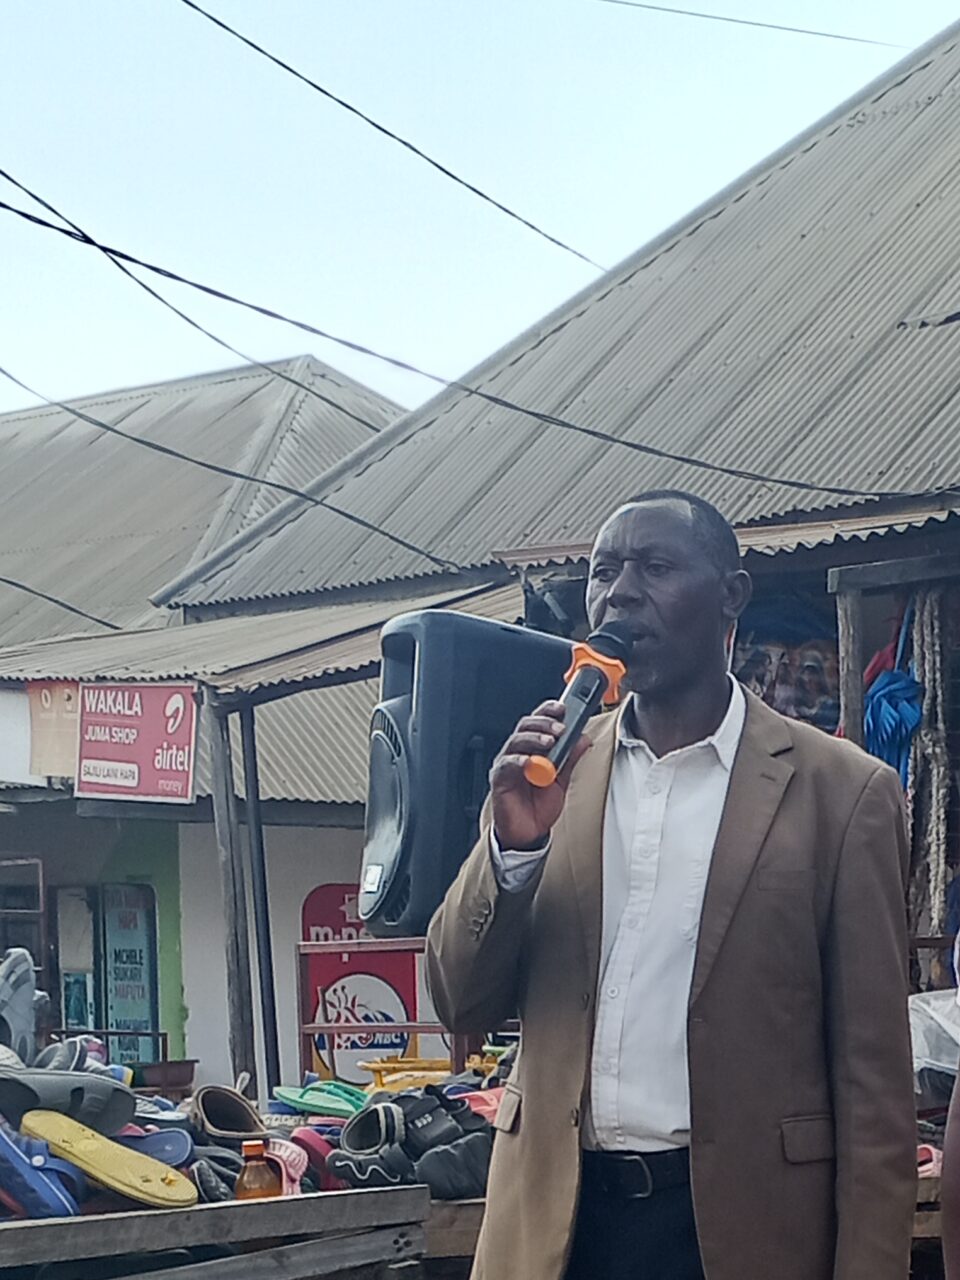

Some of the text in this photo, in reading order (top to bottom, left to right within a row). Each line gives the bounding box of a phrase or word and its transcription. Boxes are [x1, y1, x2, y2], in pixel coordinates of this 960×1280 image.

[84, 688, 142, 716] WAKALA
[84, 725, 138, 744] JUMA SHOP
[154, 741, 189, 771] airtel
[158, 780, 183, 795] money
[374, 1032, 401, 1045] NBC
